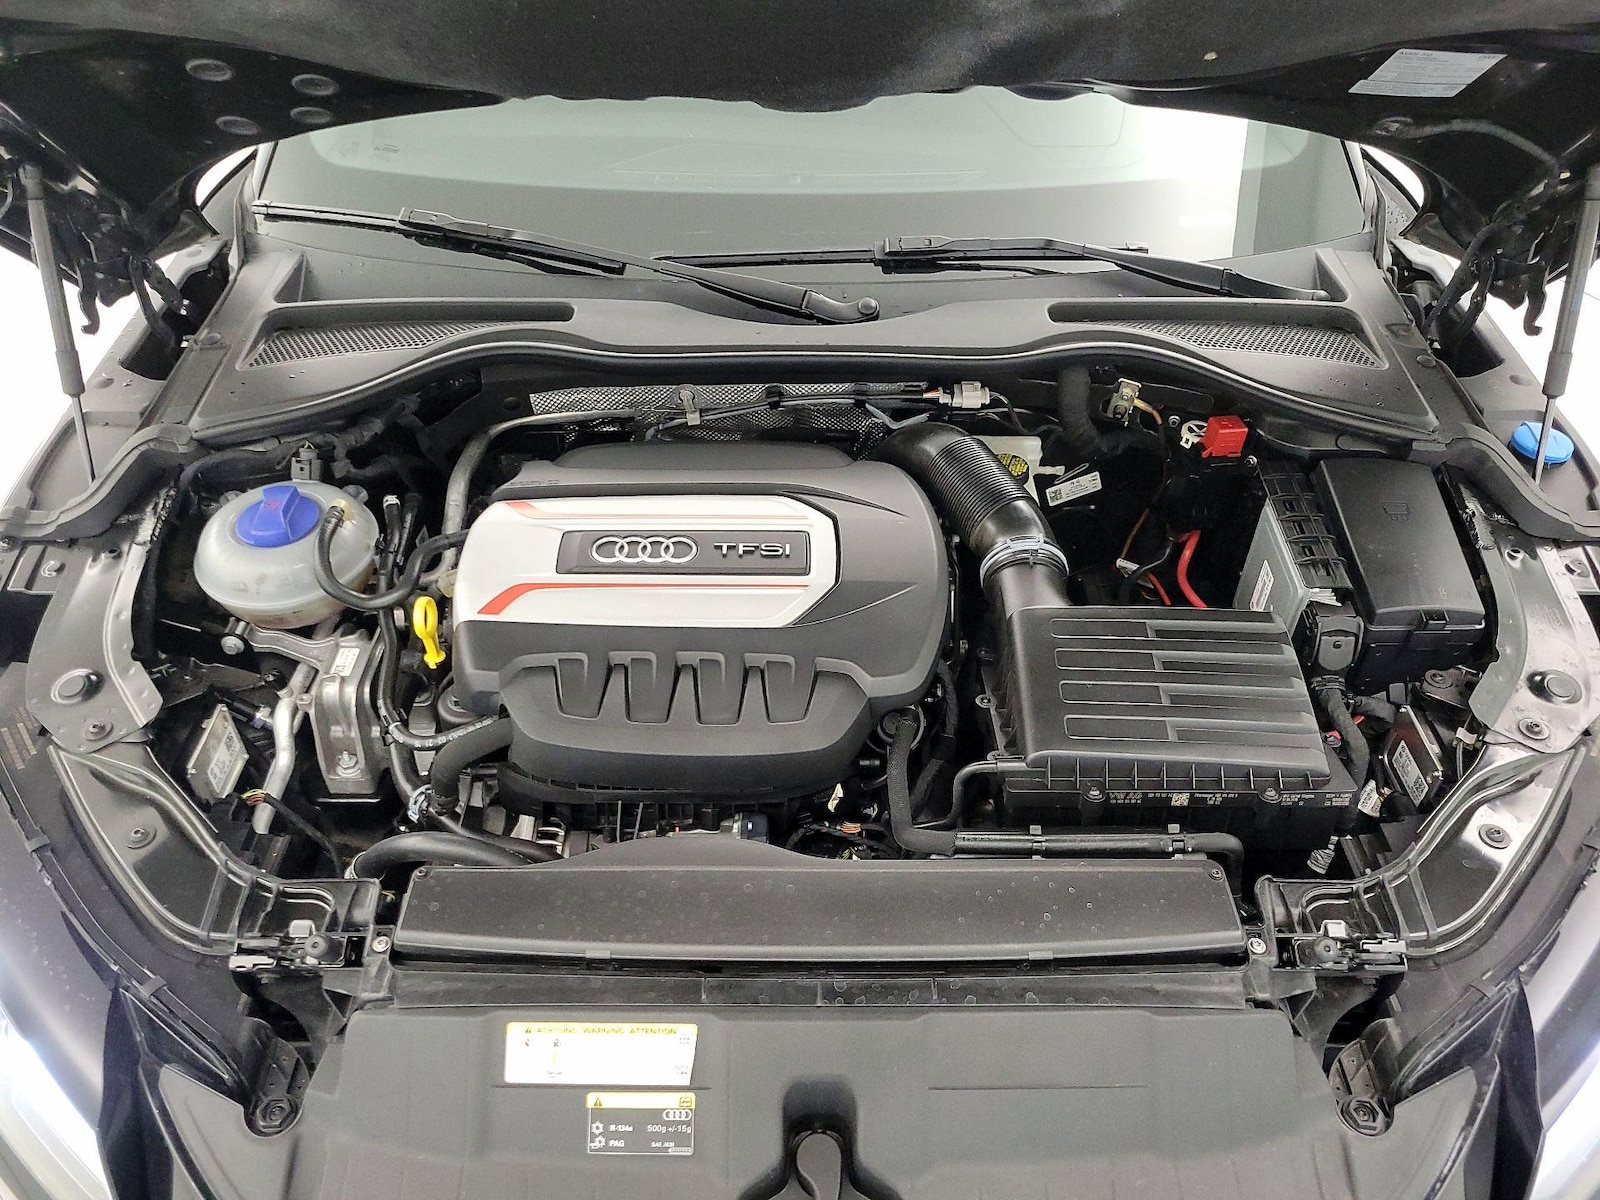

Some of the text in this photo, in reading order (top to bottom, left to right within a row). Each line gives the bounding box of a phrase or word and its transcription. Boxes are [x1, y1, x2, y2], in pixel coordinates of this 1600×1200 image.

[714, 542, 791, 558] TFSI
[646, 1124, 667, 1133] 500g
[609, 1139, 625, 1147] PAG
